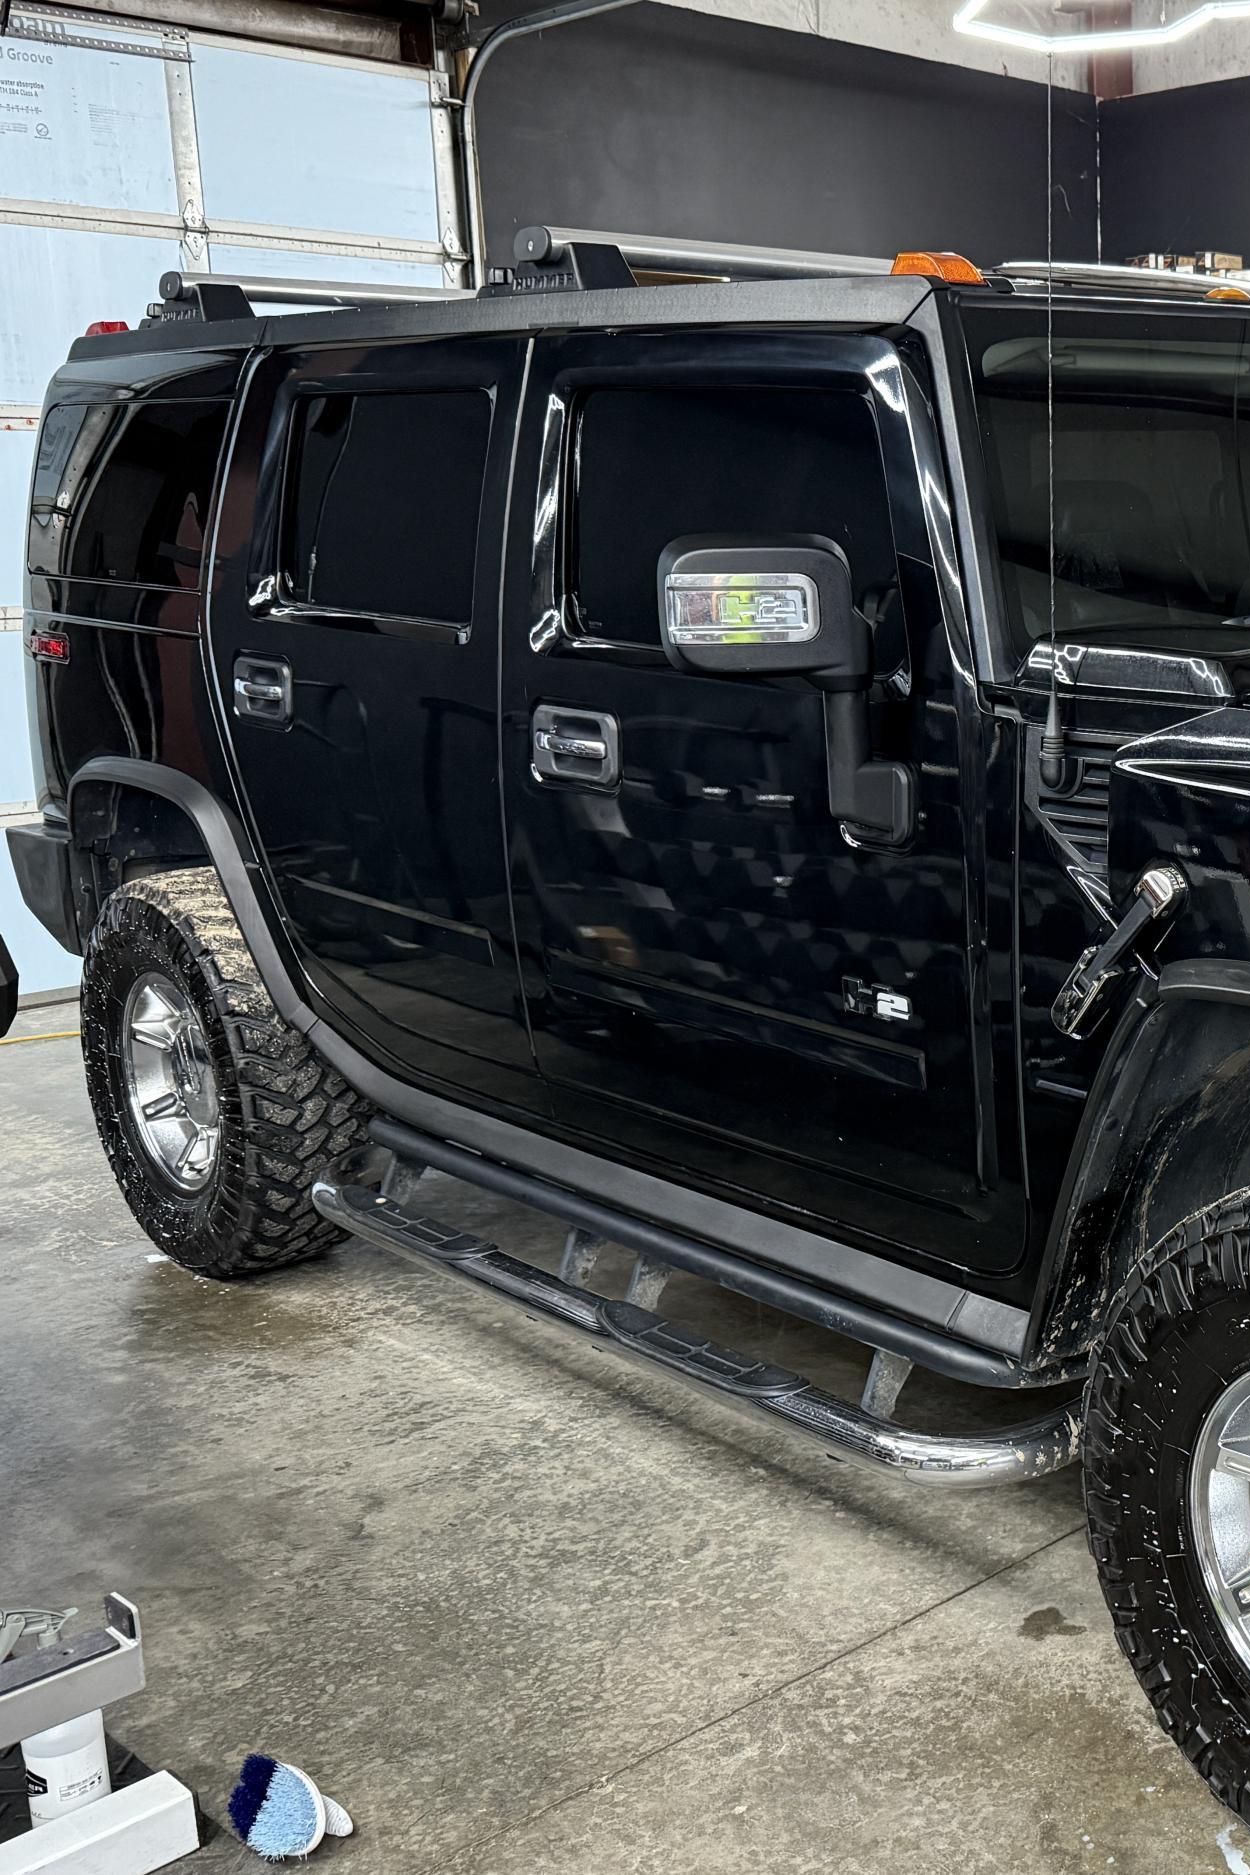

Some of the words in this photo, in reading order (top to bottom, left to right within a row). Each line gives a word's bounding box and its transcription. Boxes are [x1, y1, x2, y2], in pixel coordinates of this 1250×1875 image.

[7, 47, 53, 64] Groove
[512, 272, 576, 291] HUMMER
[842, 976, 913, 1022] H2
